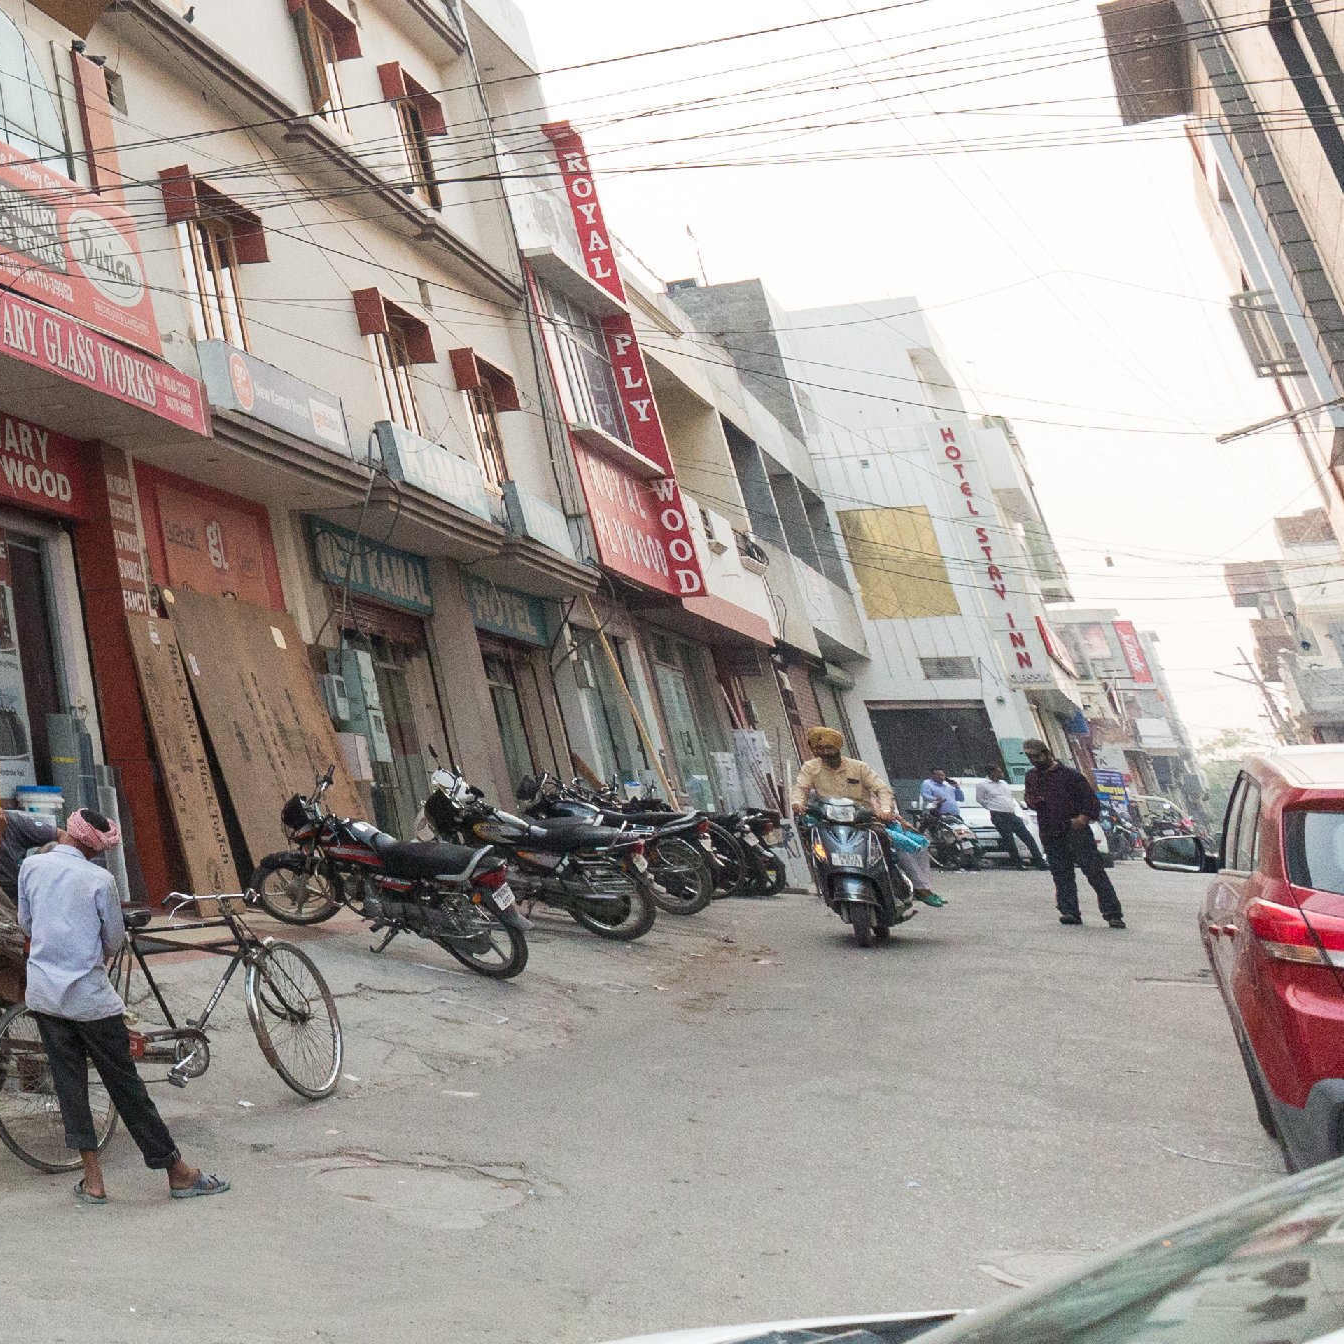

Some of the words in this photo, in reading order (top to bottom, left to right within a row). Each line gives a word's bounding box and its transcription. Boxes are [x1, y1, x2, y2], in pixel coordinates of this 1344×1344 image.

[17, 224, 68, 274] WORKS
[79, 226, 133, 285] Durian
[42, 317, 96, 382] GLASS
[98, 343, 158, 407] WORKS
[562, 150, 613, 281] ROYAL
[613, 331, 652, 423] PLY
[650, 476, 704, 595] WOOD
[588, 456, 649, 520] ROYAL
[594, 513, 669, 579] PLYWOOD
[940, 427, 979, 516] HOTEL
[975, 527, 1007, 600] STAY
[1005, 612, 1033, 669] INN
[167, 643, 184, 687] Black
[197, 757, 214, 808] Black
